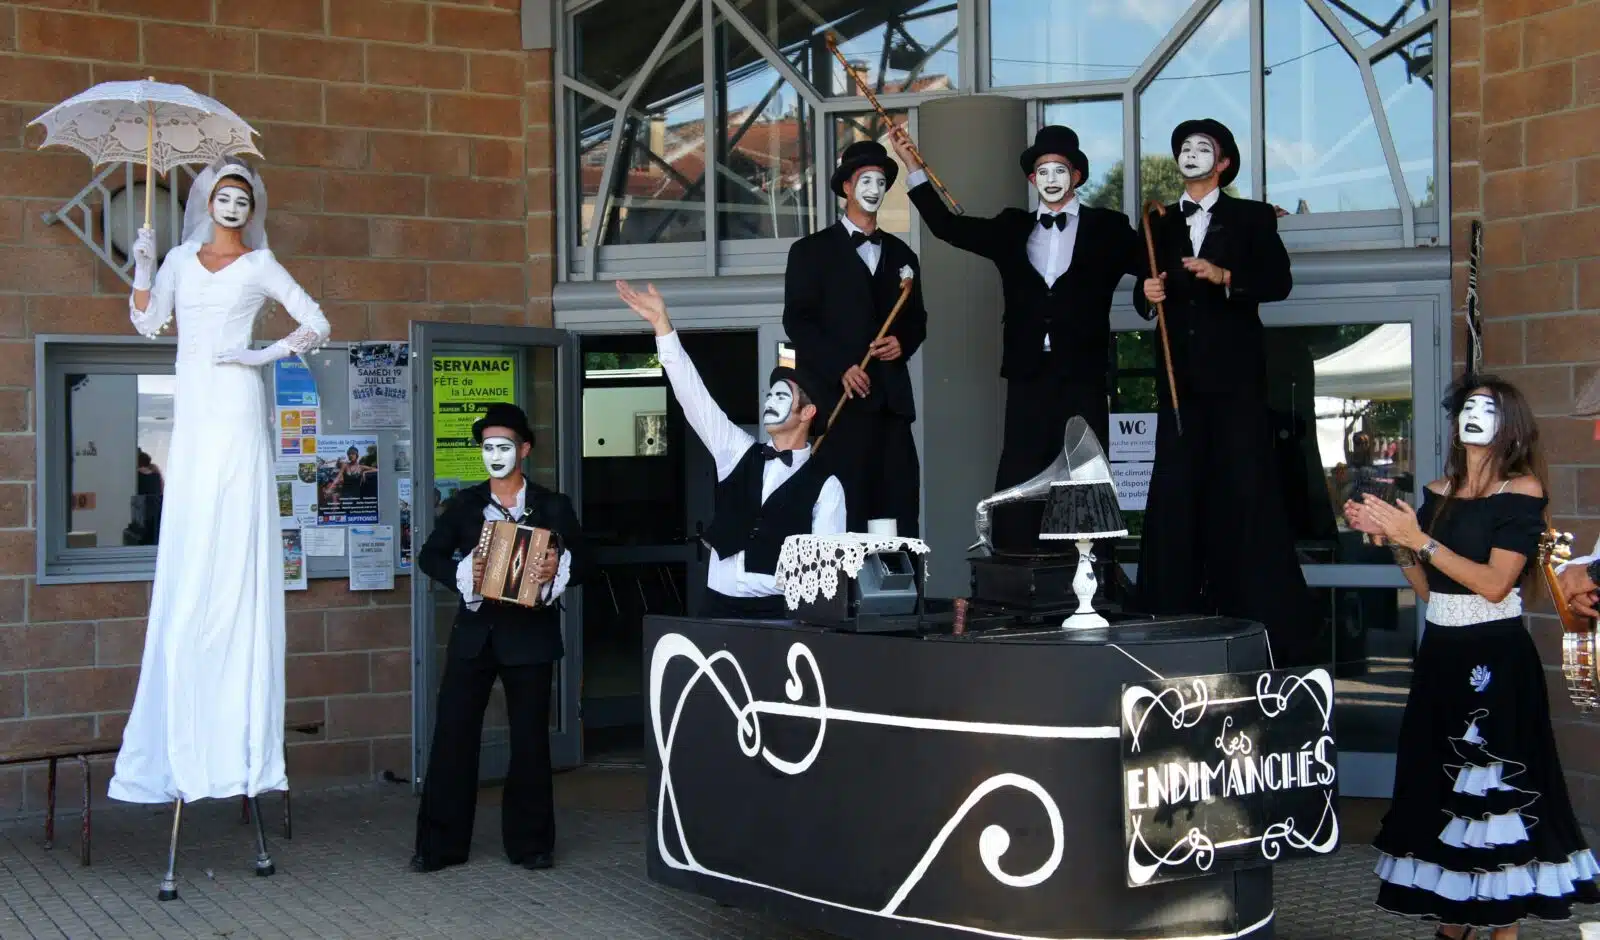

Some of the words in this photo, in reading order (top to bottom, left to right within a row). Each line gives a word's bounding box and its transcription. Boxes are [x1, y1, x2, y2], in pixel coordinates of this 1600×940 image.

[434, 360, 510, 372] SERVANAC
[434, 375, 459, 386] FÊTE
[461, 377, 473, 386] de
[375, 387, 383, 396] &
[452, 387, 460, 396] la
[462, 388, 509, 396] LAVANDE
[462, 403, 475, 412] 19
[1119, 420, 1147, 434] WC
[1121, 480, 1149, 488] disposit
[1215, 716, 1252, 755] Les
[1127, 735, 1336, 810] ENDIMANCHÉS
